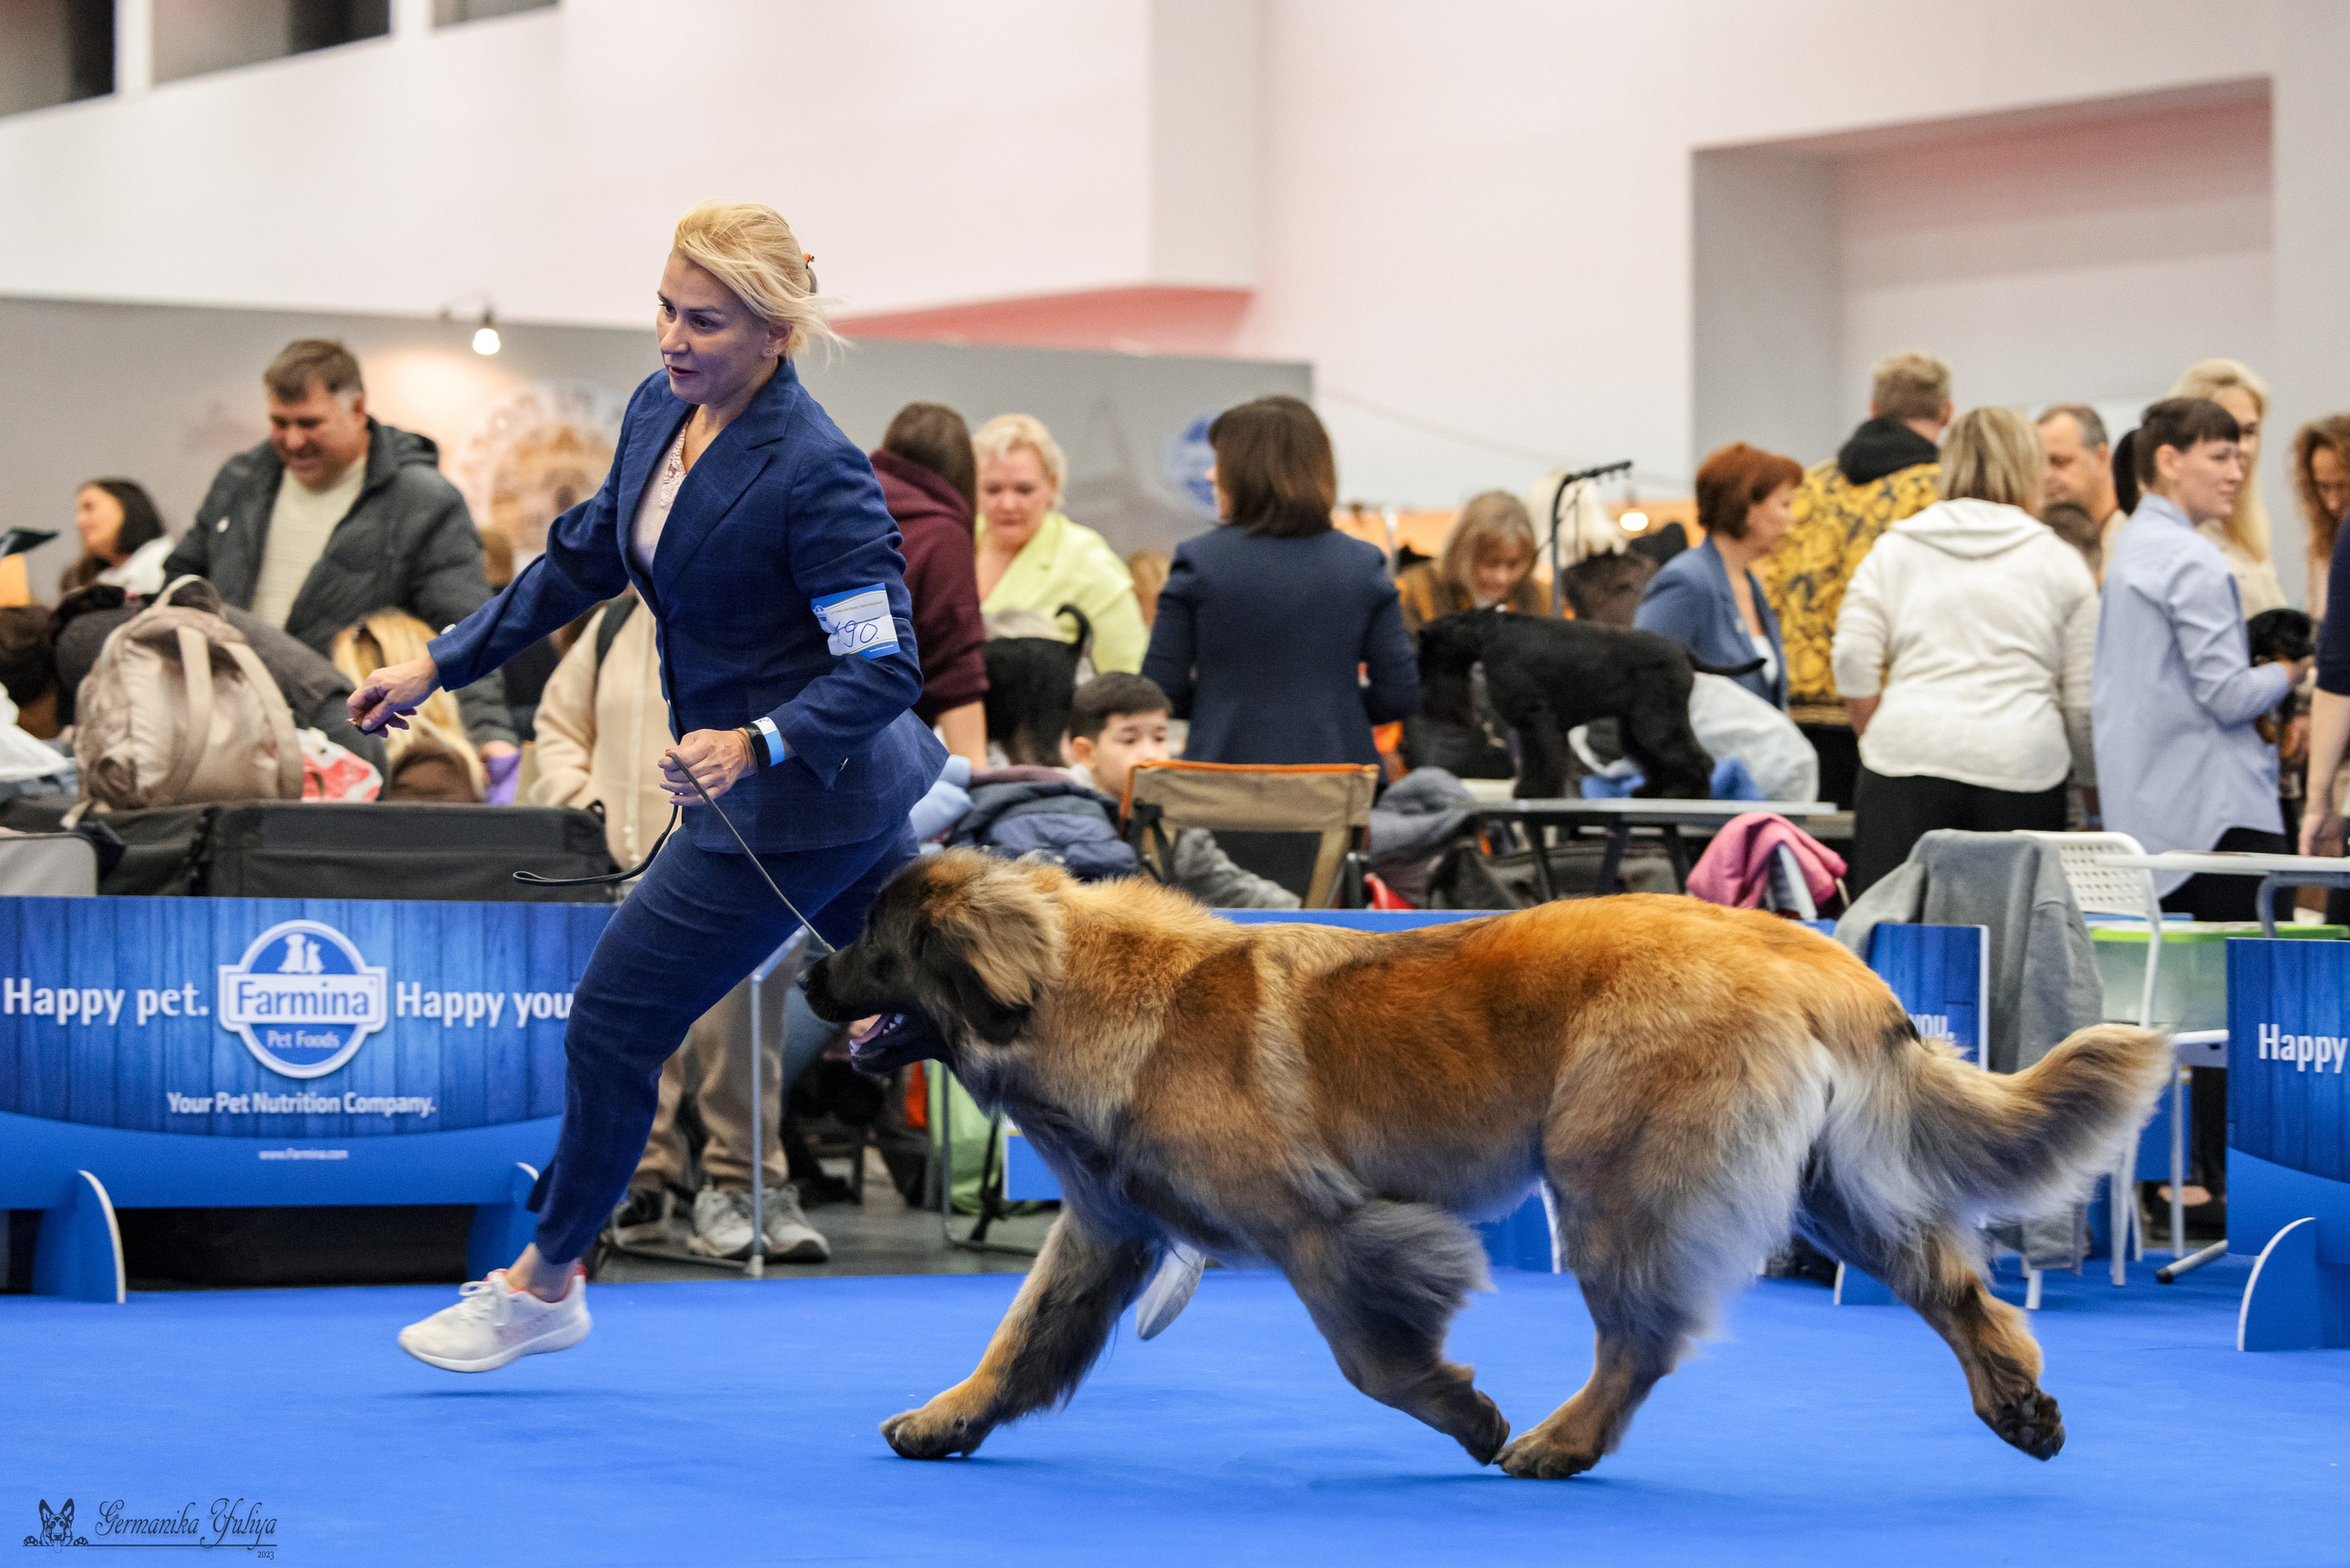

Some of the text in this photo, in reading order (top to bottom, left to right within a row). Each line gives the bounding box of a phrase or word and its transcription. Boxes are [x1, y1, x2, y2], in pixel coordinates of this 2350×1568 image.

[4, 978, 209, 1025] Happy pet.
[238, 980, 369, 1015] Farmina
[397, 981, 505, 1028] Happy
[267, 1029, 340, 1048] Pet Foods
[2258, 1023, 2349, 1073] Happy
[167, 1092, 436, 1118] Your Pet Nutrition Company.
